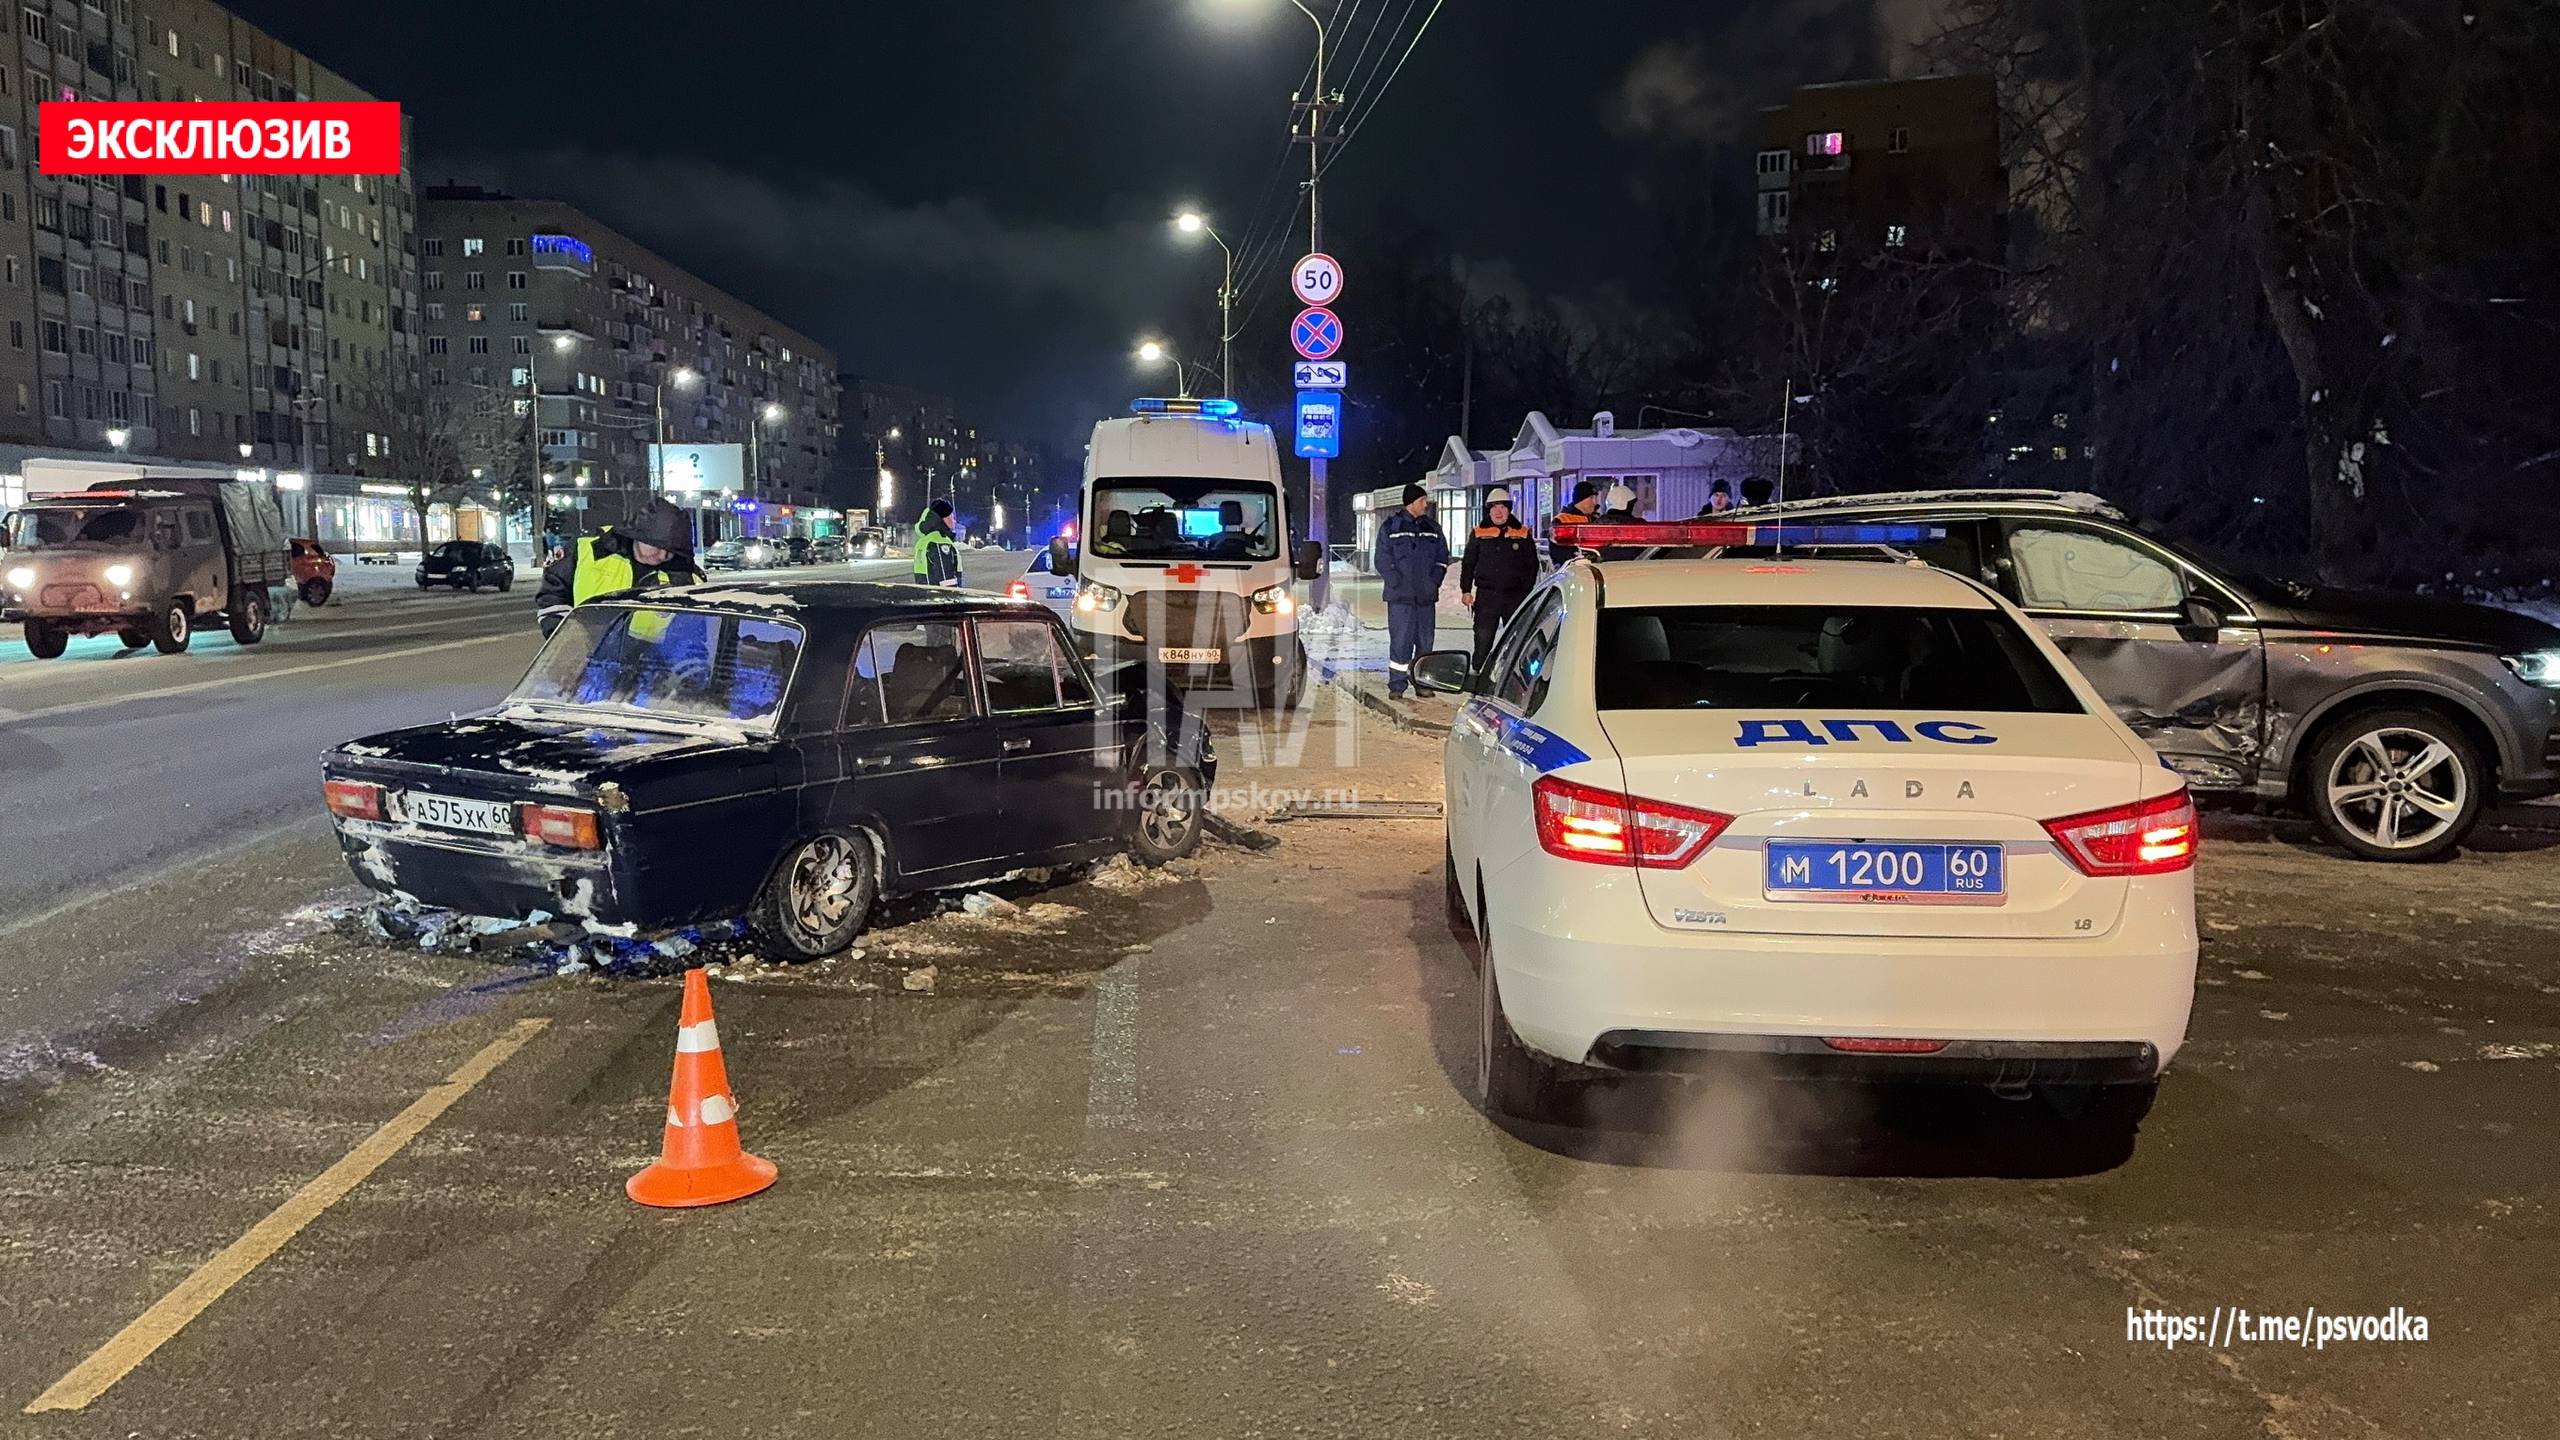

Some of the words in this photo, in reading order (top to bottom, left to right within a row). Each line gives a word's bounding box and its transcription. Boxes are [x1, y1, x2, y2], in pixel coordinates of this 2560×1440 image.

[1304, 270, 1332, 290] 50
[1734, 719, 1998, 747] ДПС
[1803, 779, 1975, 799] LADA
[492, 806, 512, 825] 60
[1828, 850, 1924, 886] 1200
[1951, 849, 1988, 877] 60
[1956, 878, 1984, 889] RUS
